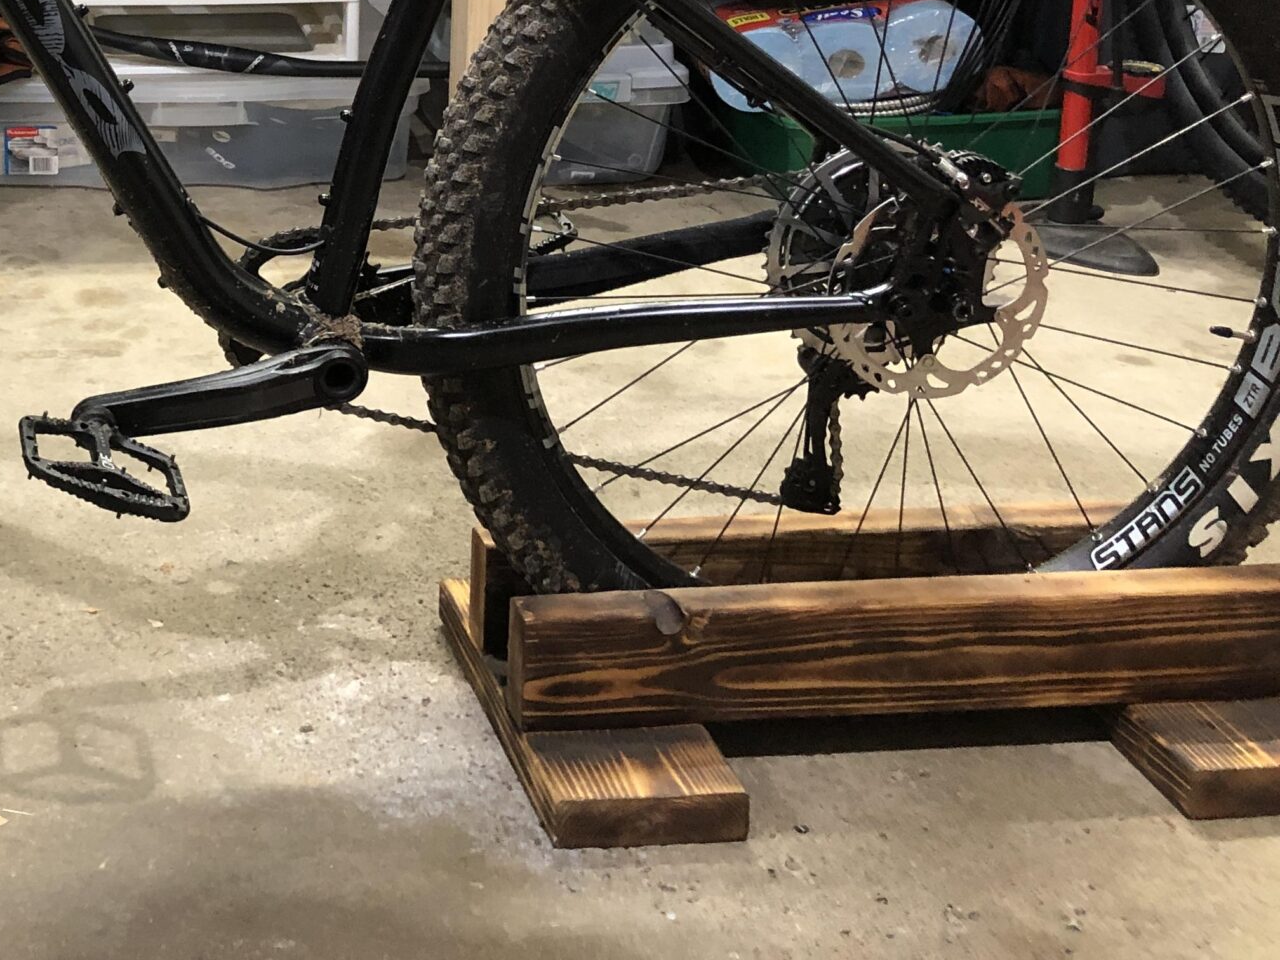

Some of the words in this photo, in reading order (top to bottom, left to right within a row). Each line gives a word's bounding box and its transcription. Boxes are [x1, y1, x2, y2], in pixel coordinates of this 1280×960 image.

[1243, 383, 1261, 409] ZTR
[1198, 454, 1216, 473] NO
[1212, 413, 1244, 456] TUBES
[1091, 466, 1205, 572] STANS
